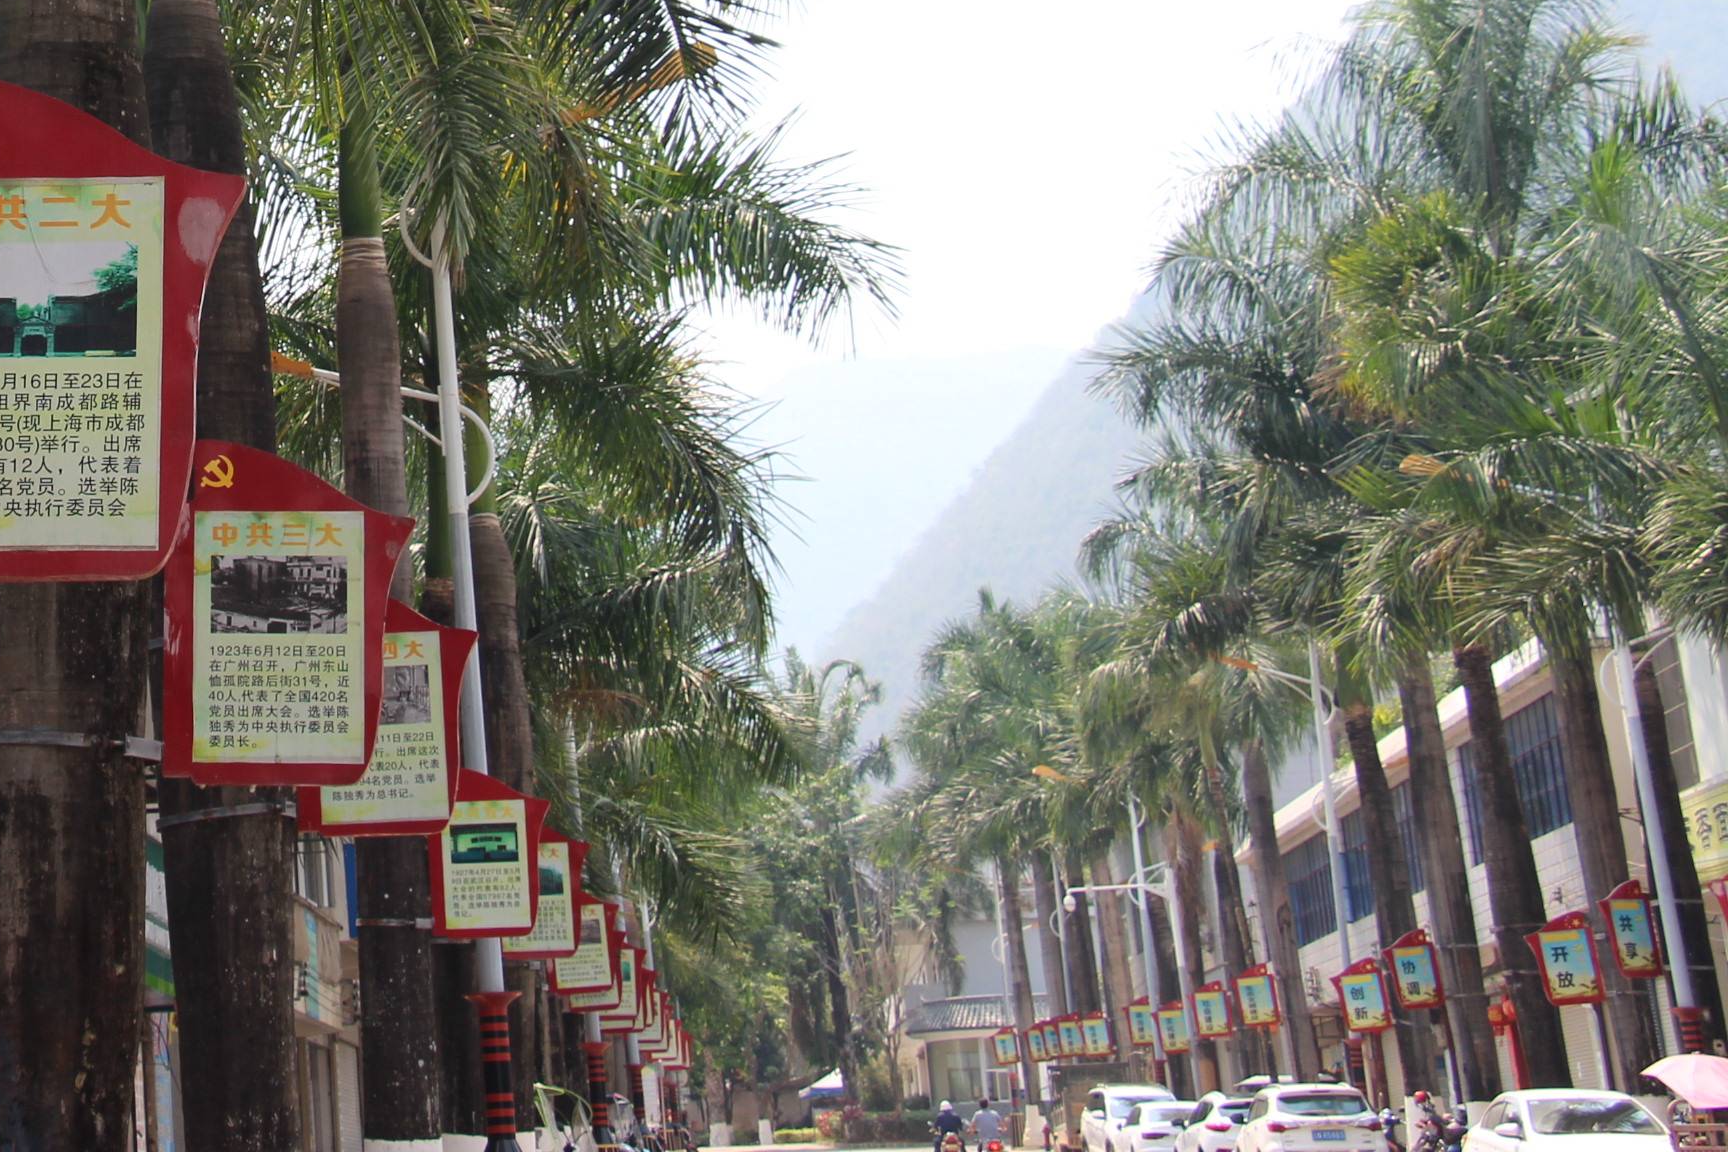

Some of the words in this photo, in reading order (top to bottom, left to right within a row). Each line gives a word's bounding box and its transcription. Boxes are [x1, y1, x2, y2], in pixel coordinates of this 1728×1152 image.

[212, 522, 343, 547] 中共三大
[210, 645, 346, 657] 1923年6月12日至20日
[209, 705, 349, 718] 党员出席大会。选举陈
[209, 720, 349, 733] 独秀为中央执行委员会
[209, 735, 257, 748] 委员长。
[375, 731, 434, 744] 11日至22日
[1618, 914, 1639, 959] 共享
[1551, 946, 1575, 988] 开放
[1350, 987, 1368, 1020] 创新
